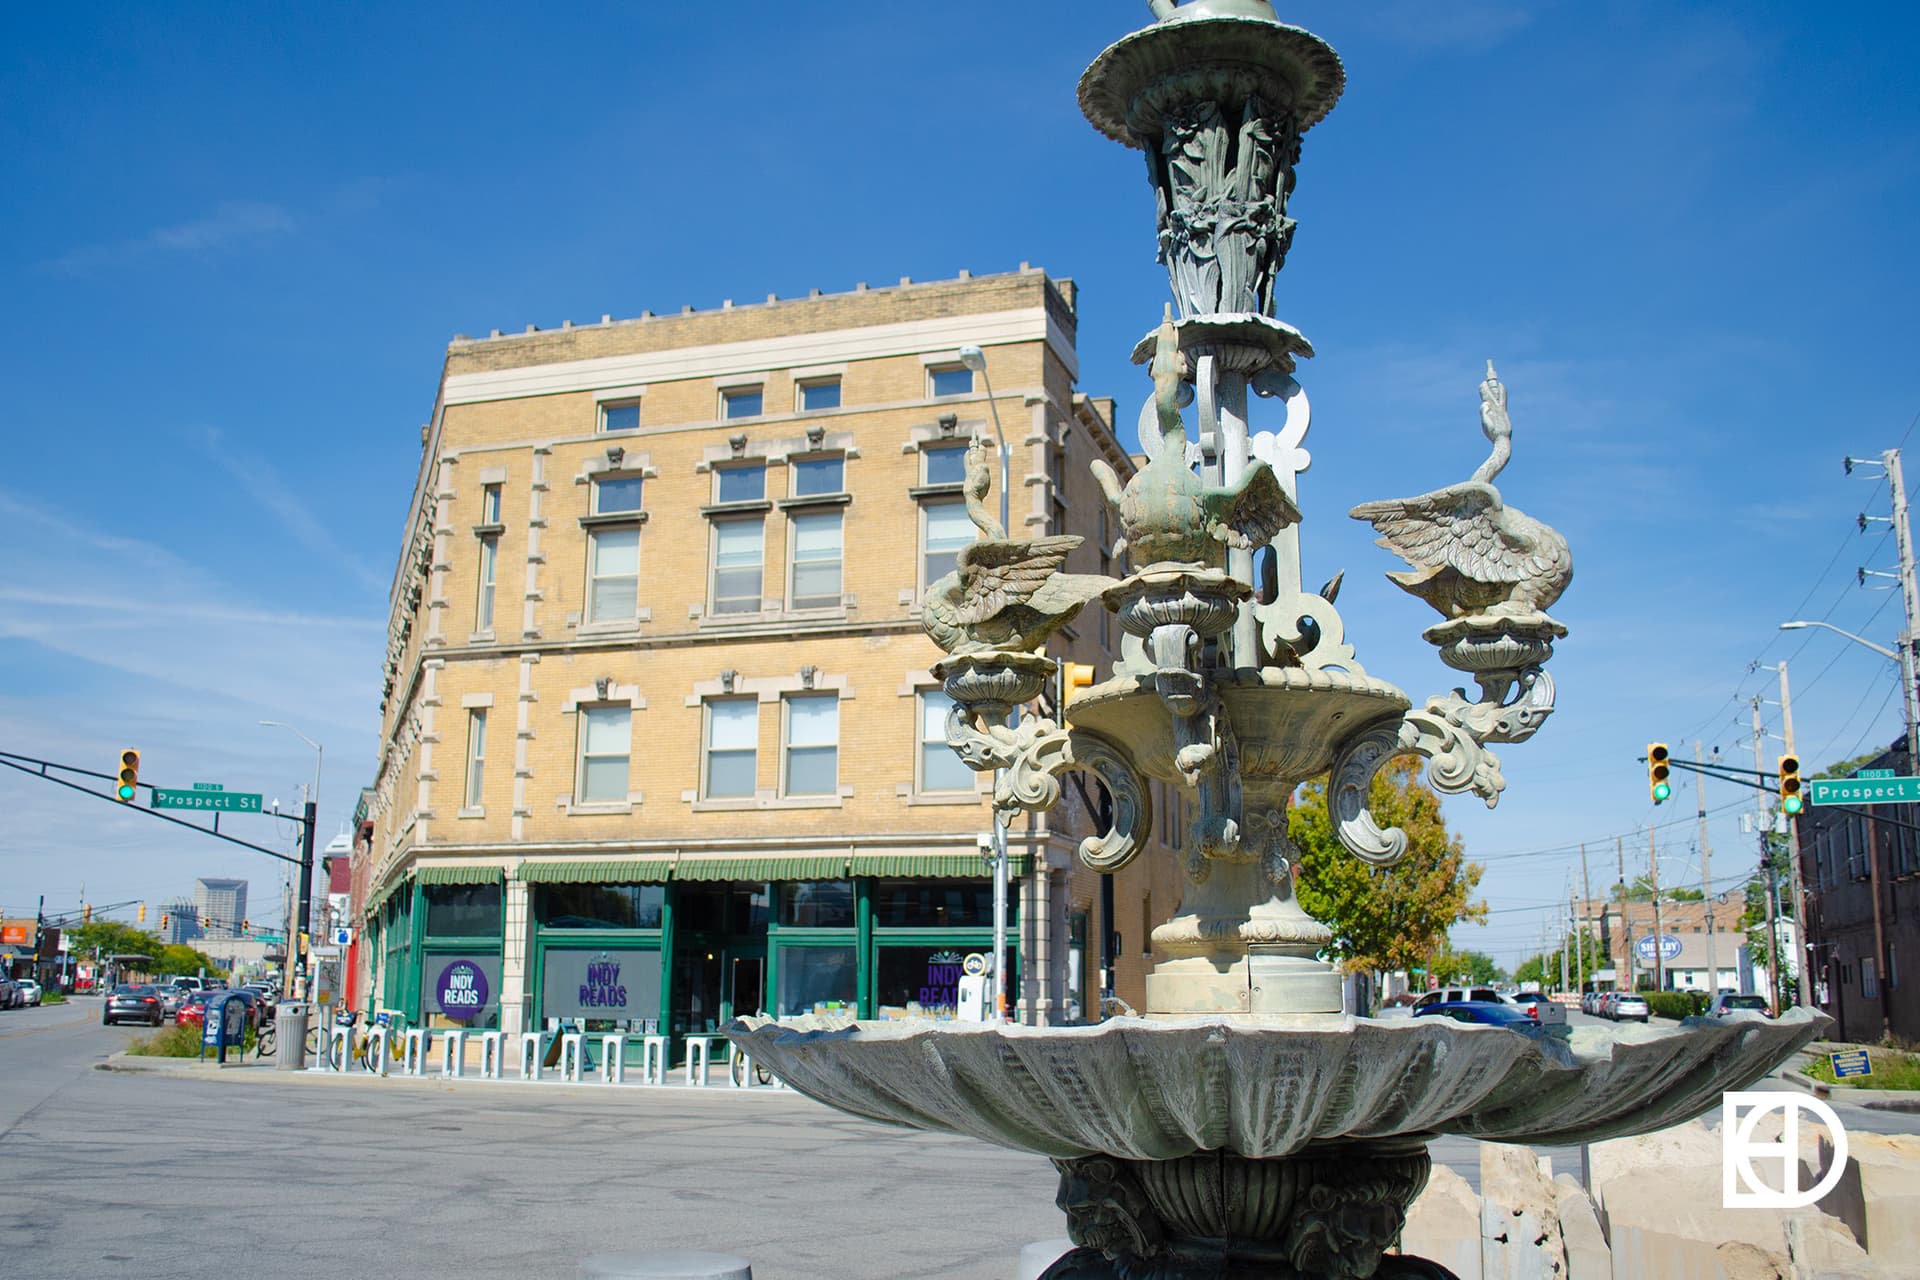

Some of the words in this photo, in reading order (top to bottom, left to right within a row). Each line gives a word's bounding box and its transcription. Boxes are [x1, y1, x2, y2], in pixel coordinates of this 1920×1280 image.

[1863, 770, 1881, 778] 1100
[1818, 784, 1904, 799] Prospect
[157, 793, 229, 808] Prospect
[240, 797, 256, 809] St
[1640, 942, 1677, 952] SHLBY
[450, 975, 474, 989] INDY
[587, 962, 620, 986] INDY
[928, 965, 963, 985] INDY
[444, 989, 478, 1005] READS
[579, 985, 627, 1007] READS
[920, 987, 958, 1008] READ
